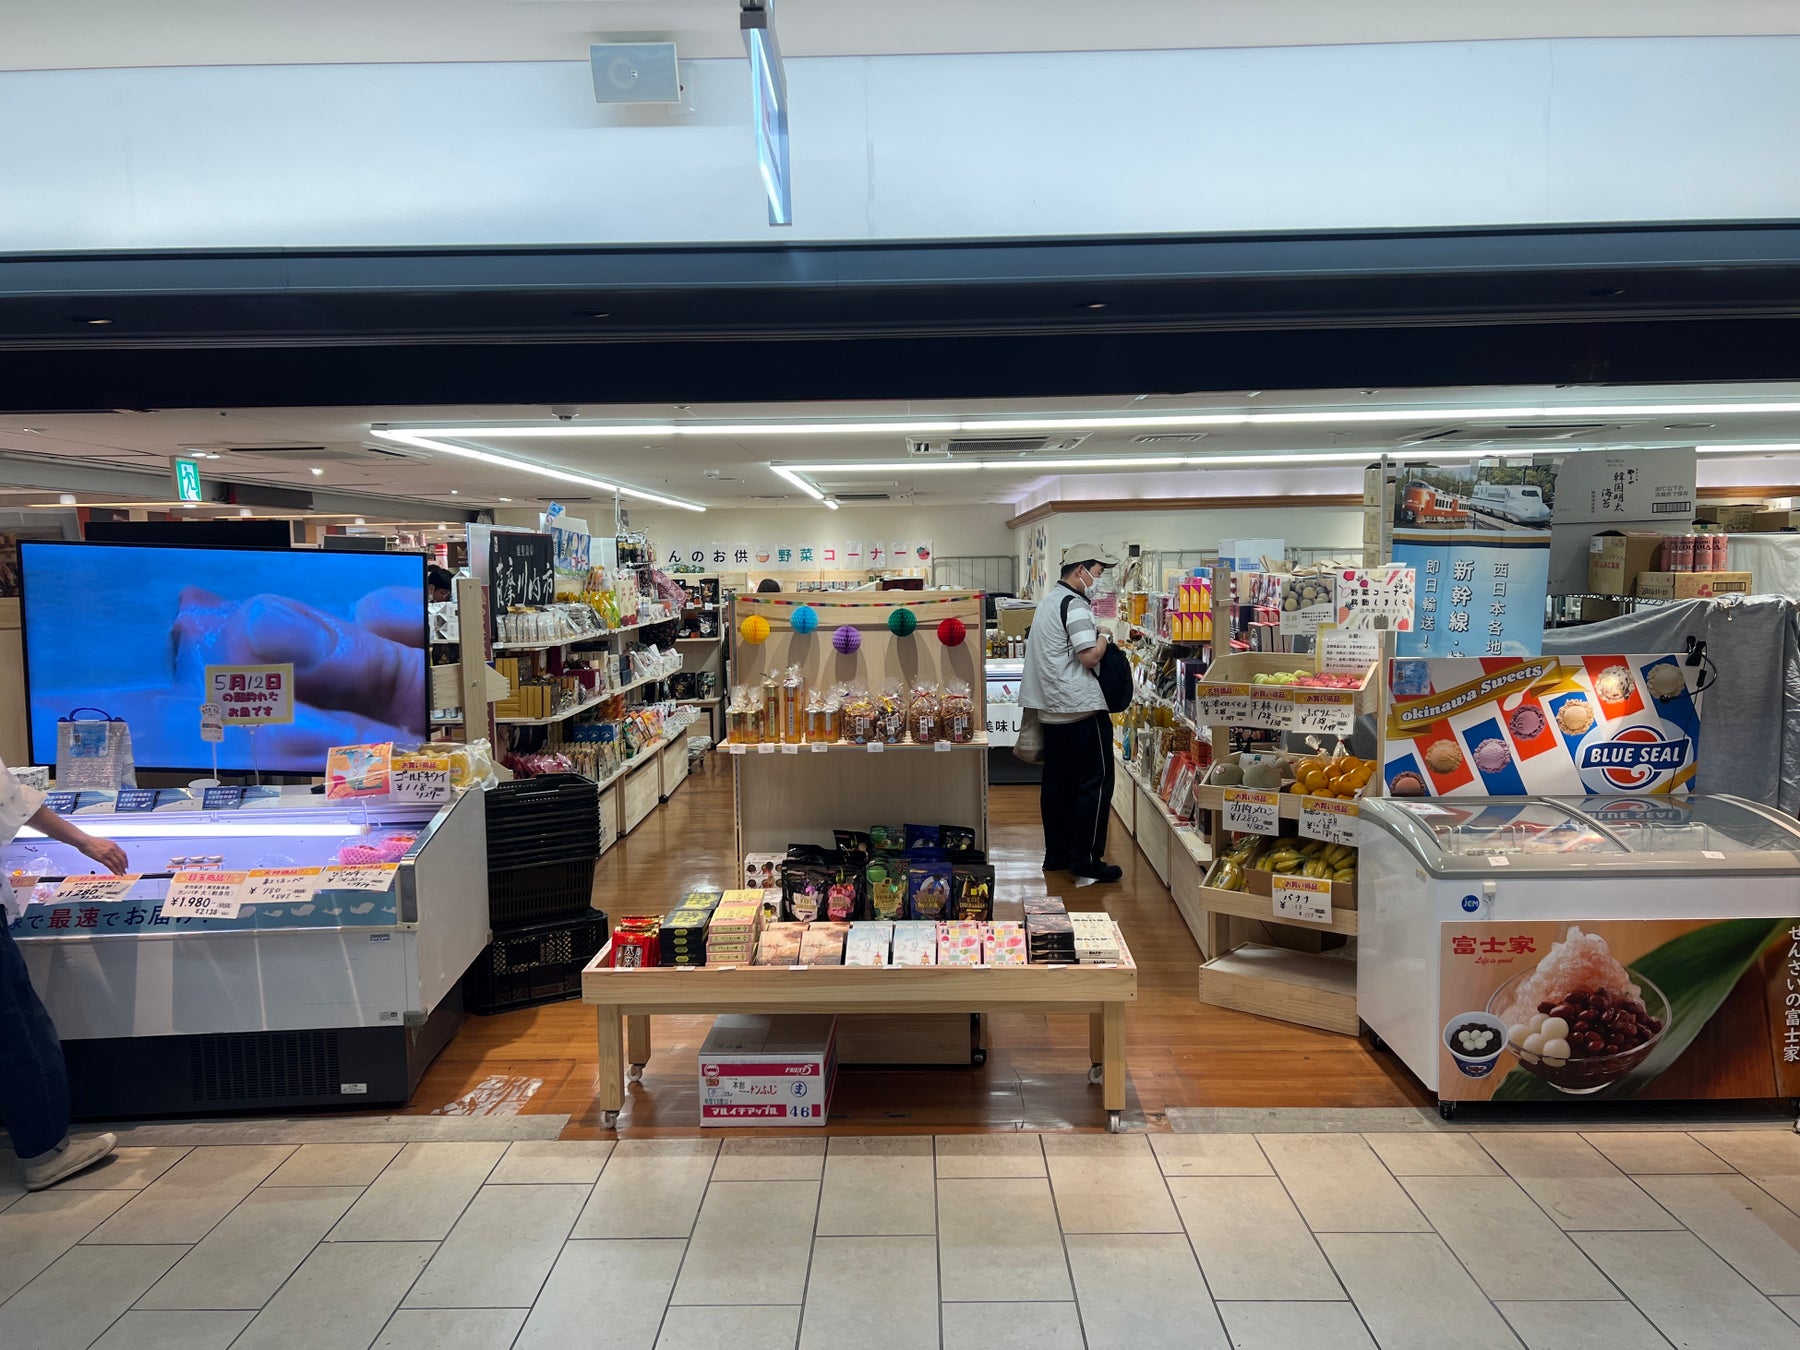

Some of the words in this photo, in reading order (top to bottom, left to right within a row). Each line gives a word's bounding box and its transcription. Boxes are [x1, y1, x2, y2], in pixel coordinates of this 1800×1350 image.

[778, 548, 907, 563] 野菜コーナー
[1420, 559, 1440, 649] 即日輸送!
[1486, 562, 1509, 656] 西日本各地
[214, 673, 282, 690] 5月12日
[1402, 689, 1478, 723] okinawa
[1480, 663, 1544, 696] Sweets
[1307, 695, 1341, 703] お買い得品
[228, 706, 273, 717] お魚です
[1590, 746, 1633, 763] BLUE
[1638, 746, 1681, 763] SEAL
[402, 761, 437, 769] お買い得品
[1235, 793, 1267, 802] お買い得品
[1313, 801, 1348, 813] お買い得品
[1285, 881, 1318, 890] お買い得品
[1283, 893, 1309, 903] バナナ
[1463, 899, 1479, 907] JCM
[9, 906, 208, 930] で最速でお届
[1452, 935, 1537, 955] 富士家
[1474, 957, 1489, 966] Life
[794, 1083, 803, 1095] ま
[711, 1105, 778, 1116] マルイチアップル
[789, 1106, 810, 1117] 46
